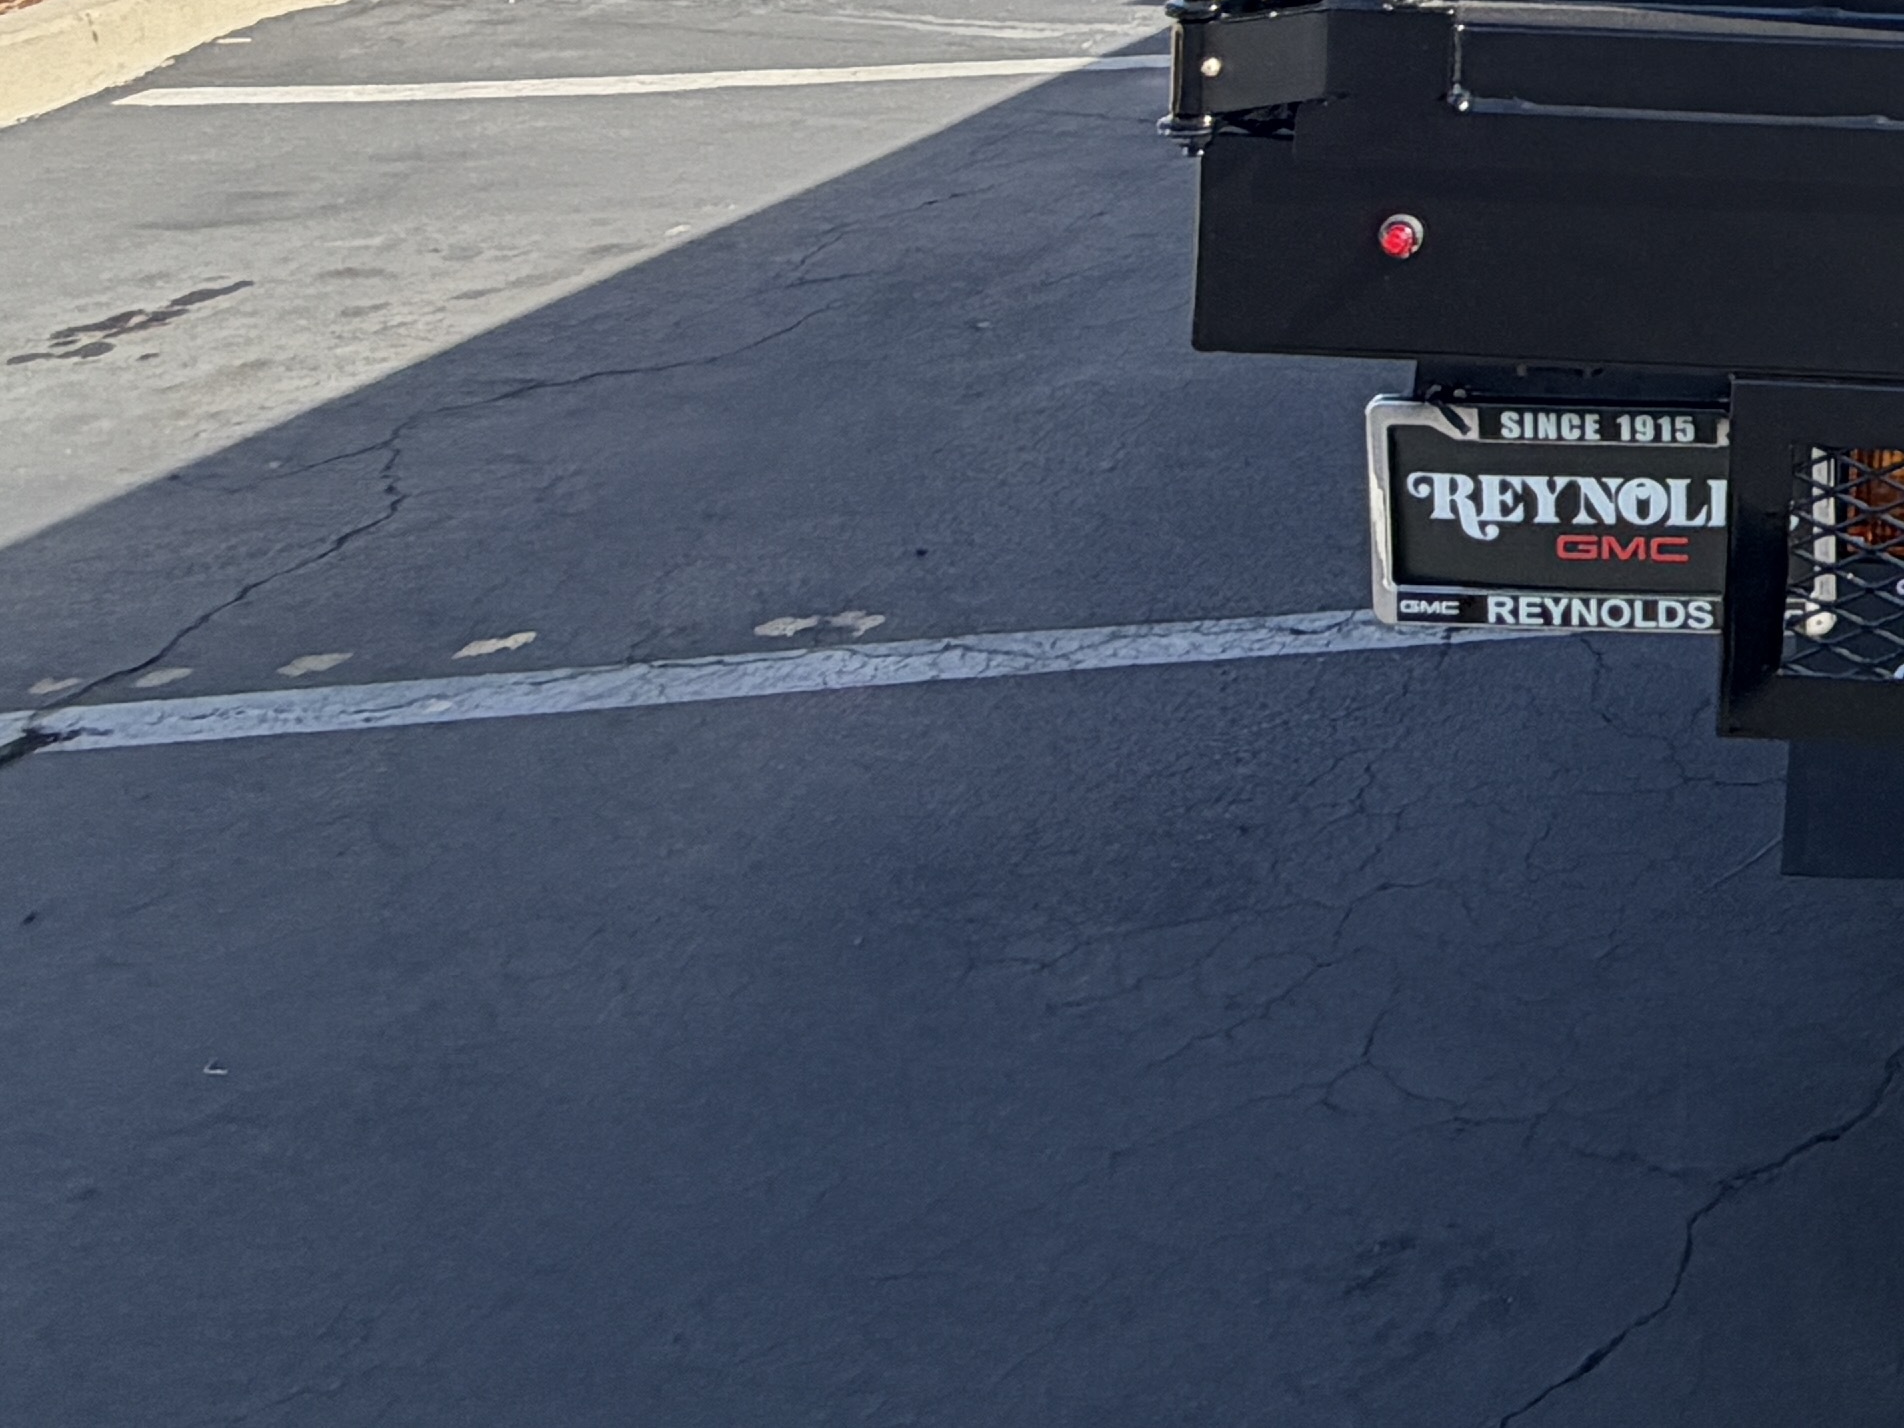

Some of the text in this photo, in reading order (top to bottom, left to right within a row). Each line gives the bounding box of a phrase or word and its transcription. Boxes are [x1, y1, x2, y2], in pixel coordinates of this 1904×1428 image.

[1501, 411, 1695, 443] SINCE 1915
[1556, 534, 1689, 563] GMC
[1400, 595, 1714, 630] GMC REYNOLDS
